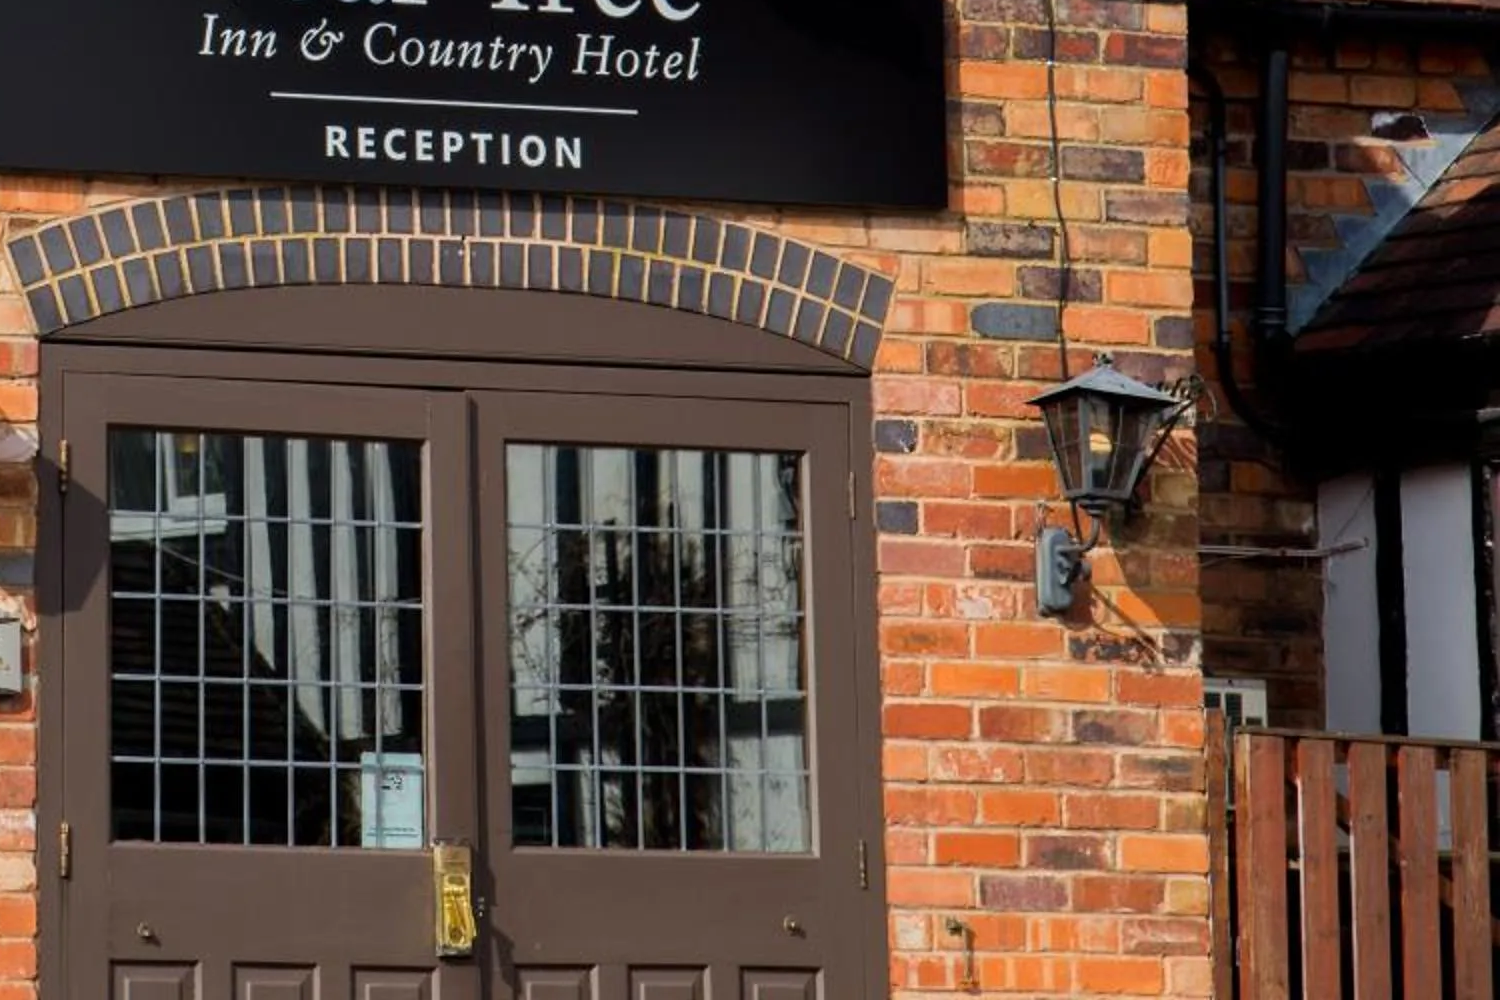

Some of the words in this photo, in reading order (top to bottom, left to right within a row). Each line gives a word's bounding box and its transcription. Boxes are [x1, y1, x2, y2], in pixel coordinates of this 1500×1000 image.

[197, 12, 278, 59] Inn
[299, 17, 345, 62] &
[363, 21, 555, 85] Country
[571, 32, 702, 82] Hotel
[324, 124, 583, 170] RECEPTION
